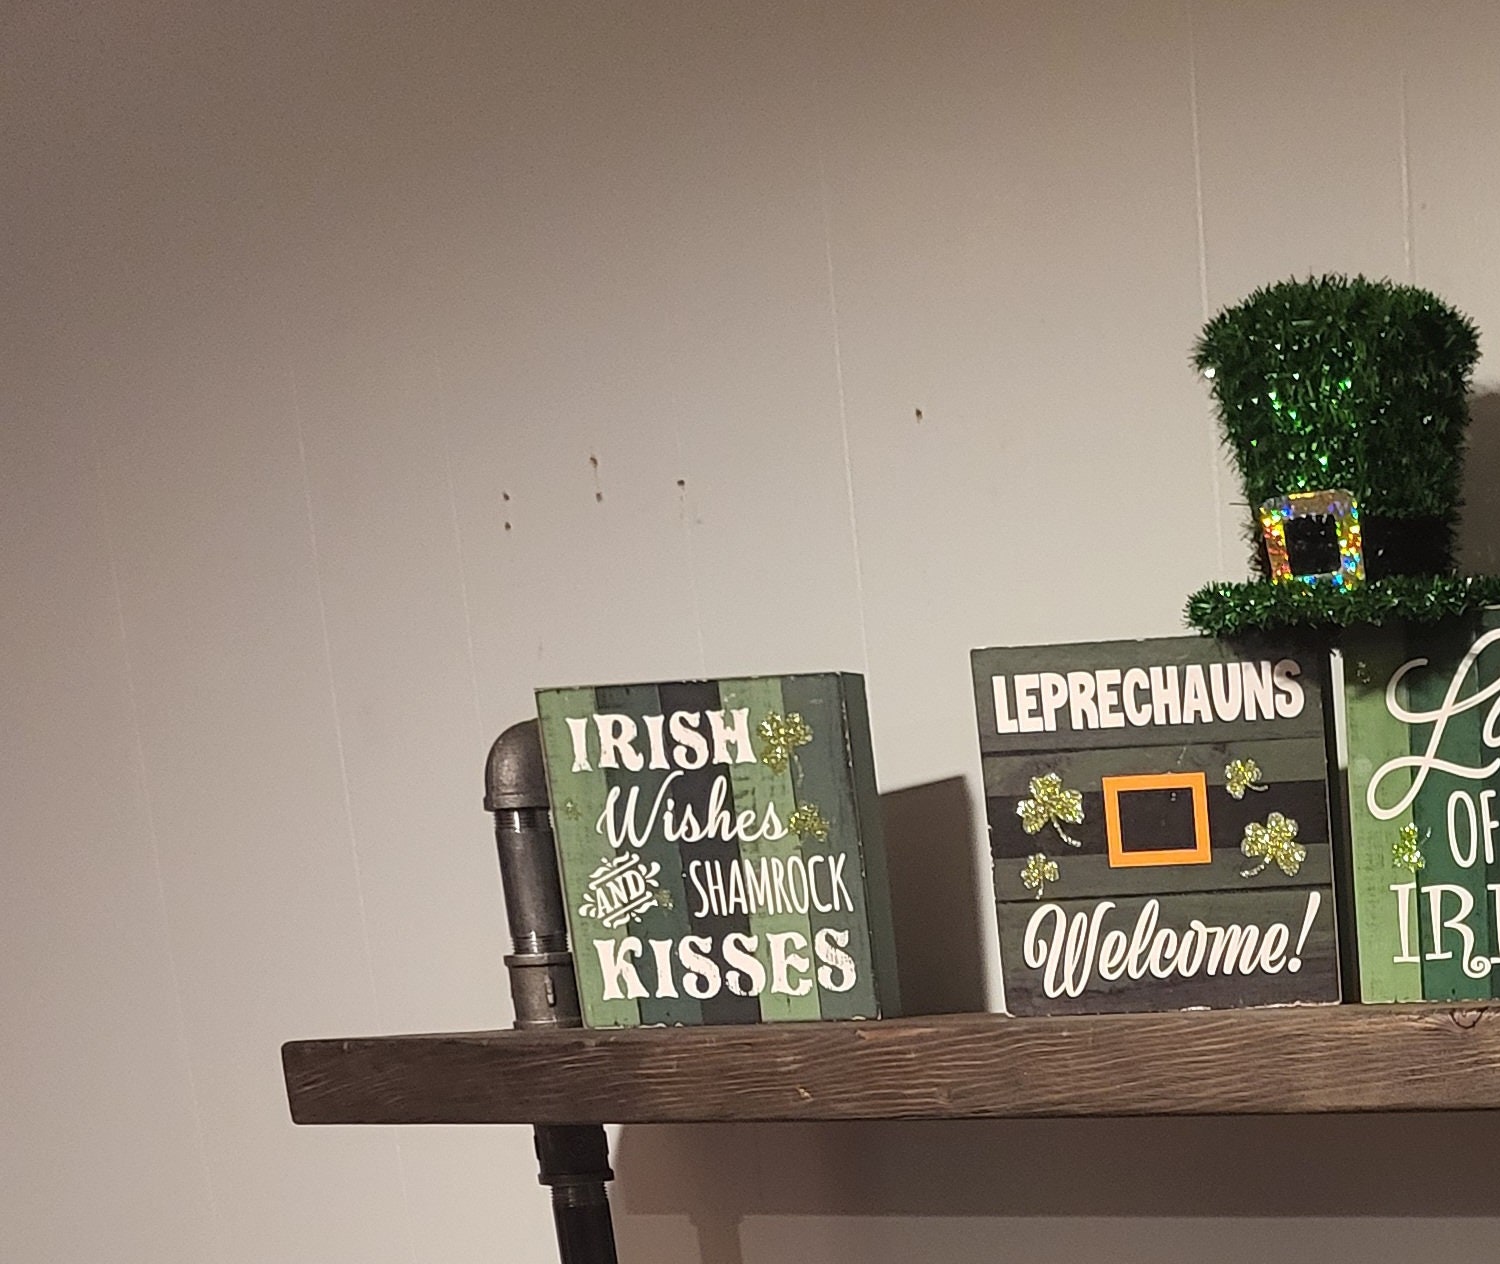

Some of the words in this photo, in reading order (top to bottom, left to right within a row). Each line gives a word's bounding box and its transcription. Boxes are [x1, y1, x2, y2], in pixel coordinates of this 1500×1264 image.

[992, 659, 1305, 734] LEPRECHAUNS
[565, 707, 757, 773] IRISH
[596, 770, 789, 848] Wishes
[1447, 789, 1500, 868] OF
[595, 869, 646, 919] AND
[689, 853, 854, 918] SHAMROCK
[593, 928, 857, 1000] KISSES
[1023, 891, 1321, 998] Welcome!
